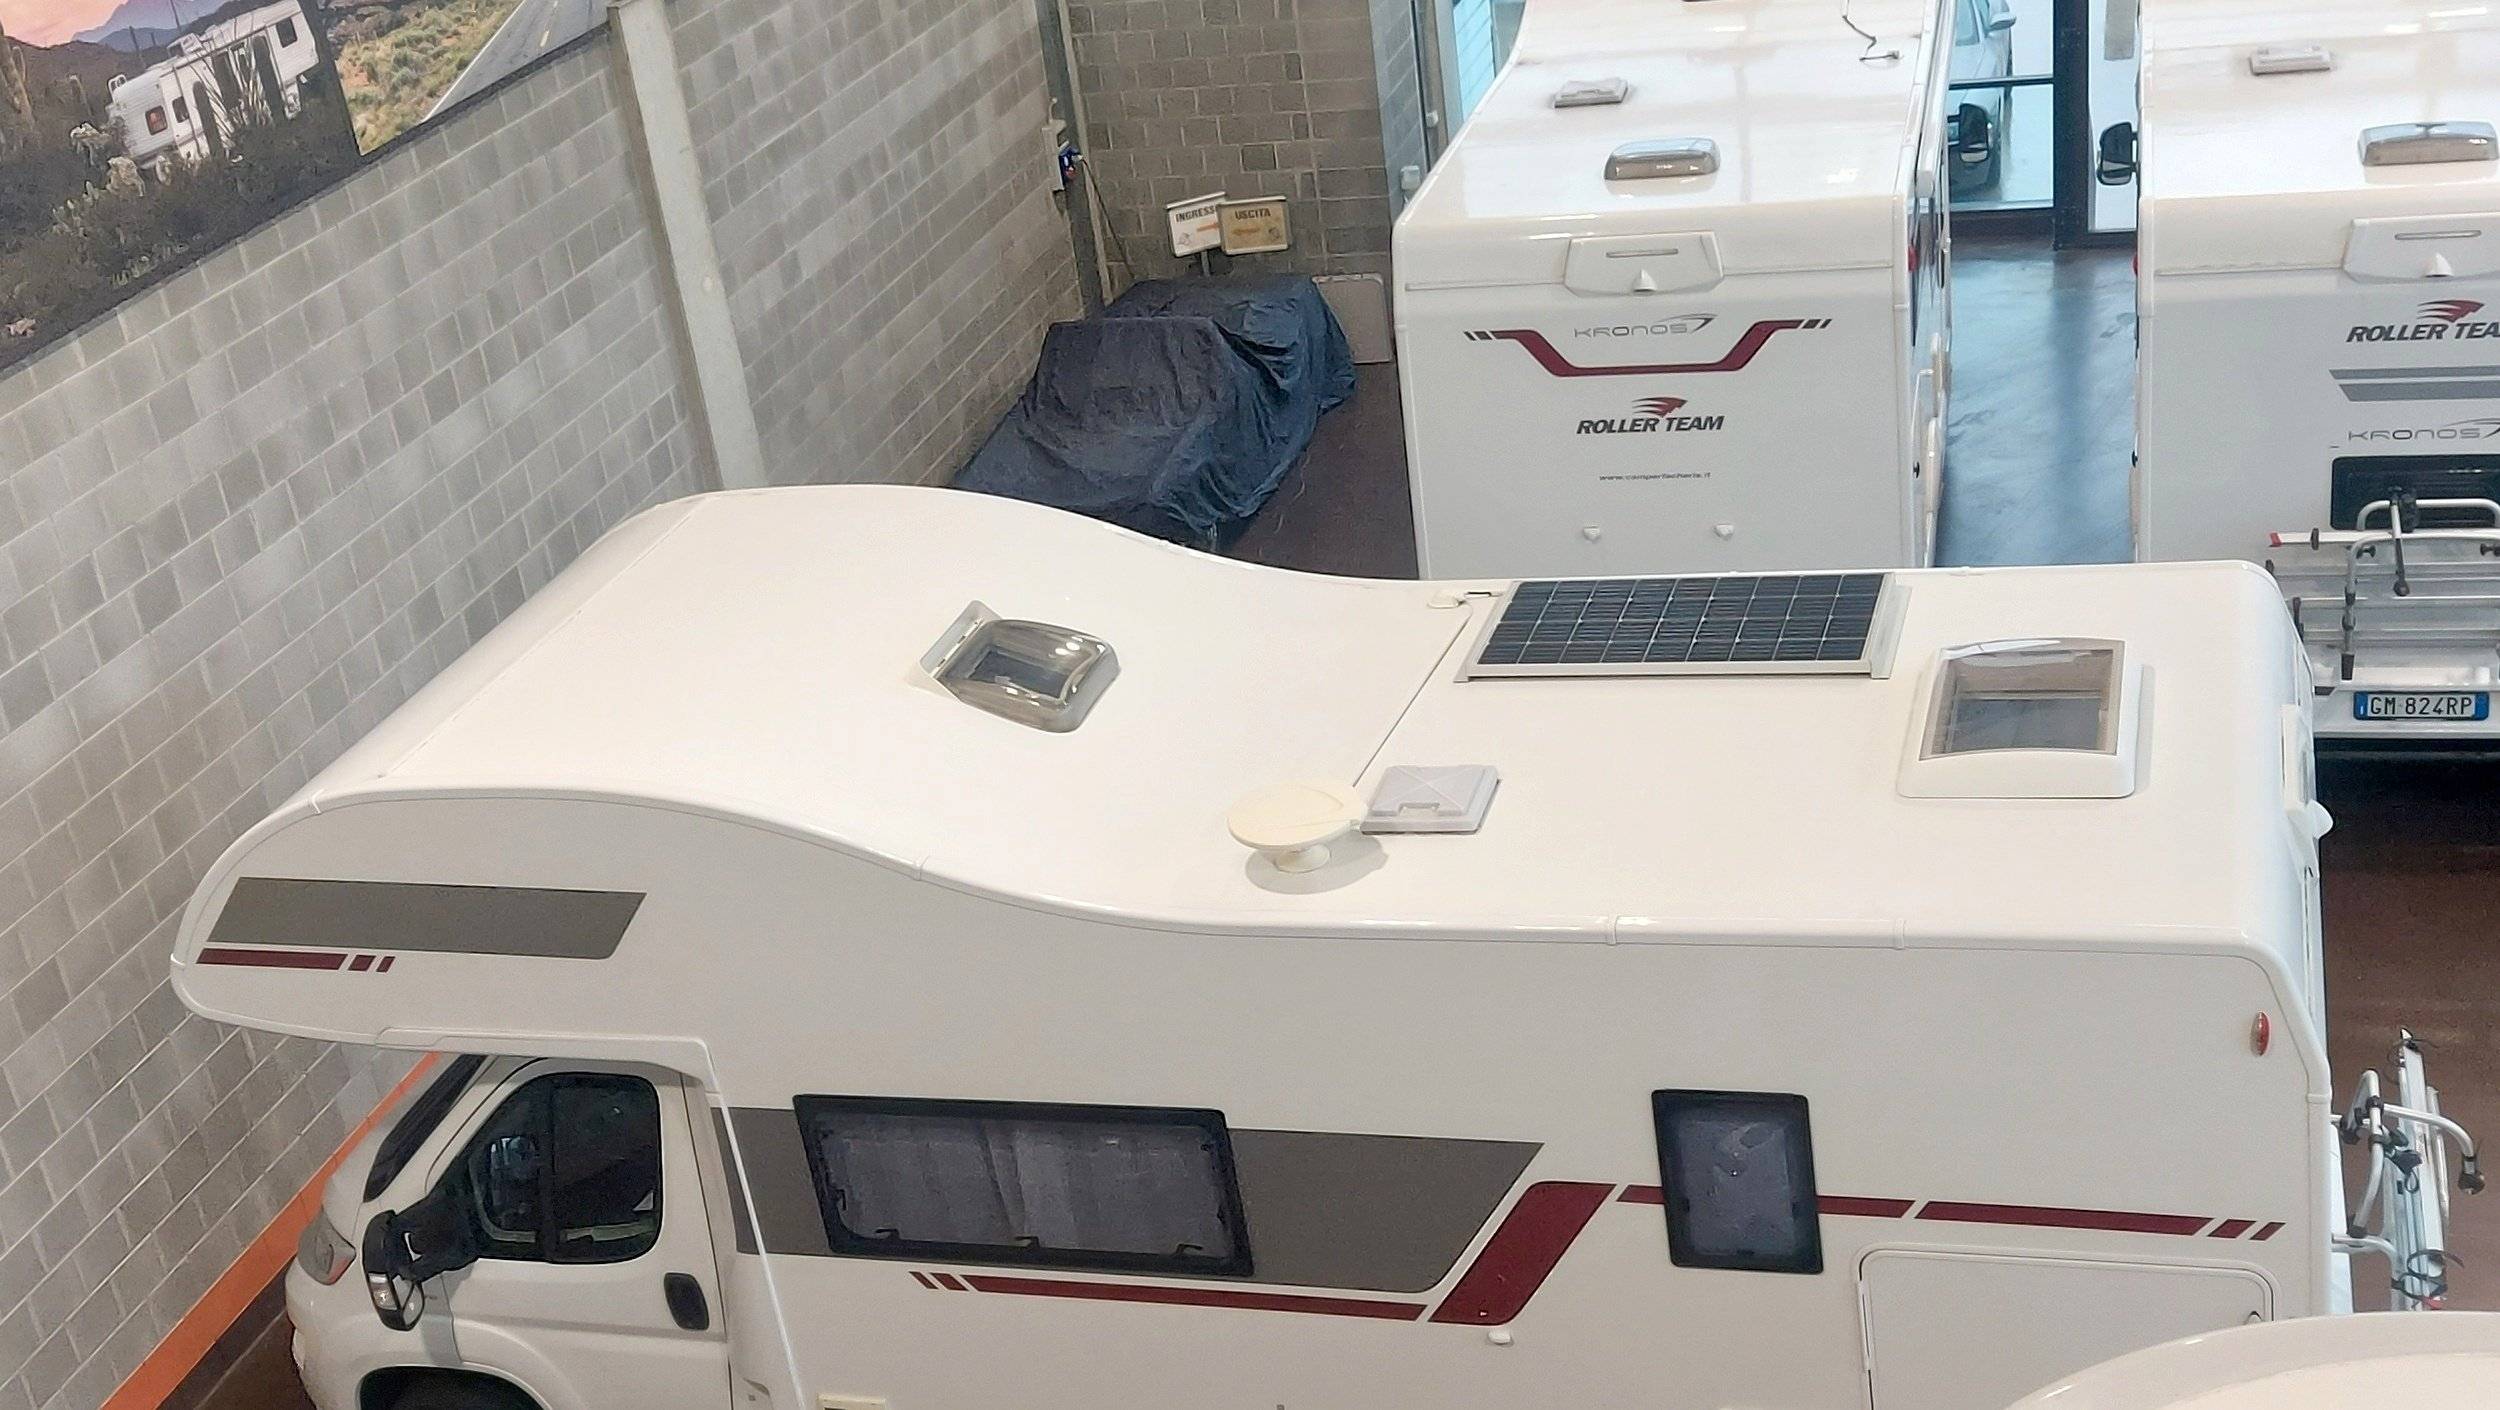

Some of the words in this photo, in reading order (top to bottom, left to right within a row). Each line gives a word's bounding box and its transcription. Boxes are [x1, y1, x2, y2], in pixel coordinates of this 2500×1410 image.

[1176, 206, 1215, 222] INGRESS
[1235, 208, 1271, 220] USCITA
[1574, 322, 1688, 338] KRONOS
[2347, 325, 2449, 342] ROLLER
[2455, 323, 2500, 339] TEA
[1577, 418, 1660, 434] ROLLER
[1666, 415, 1725, 432] TEAM
[2348, 427, 2481, 442] KRONOS
[2371, 697, 2396, 714] GM
[2405, 697, 2472, 714] 824RP
